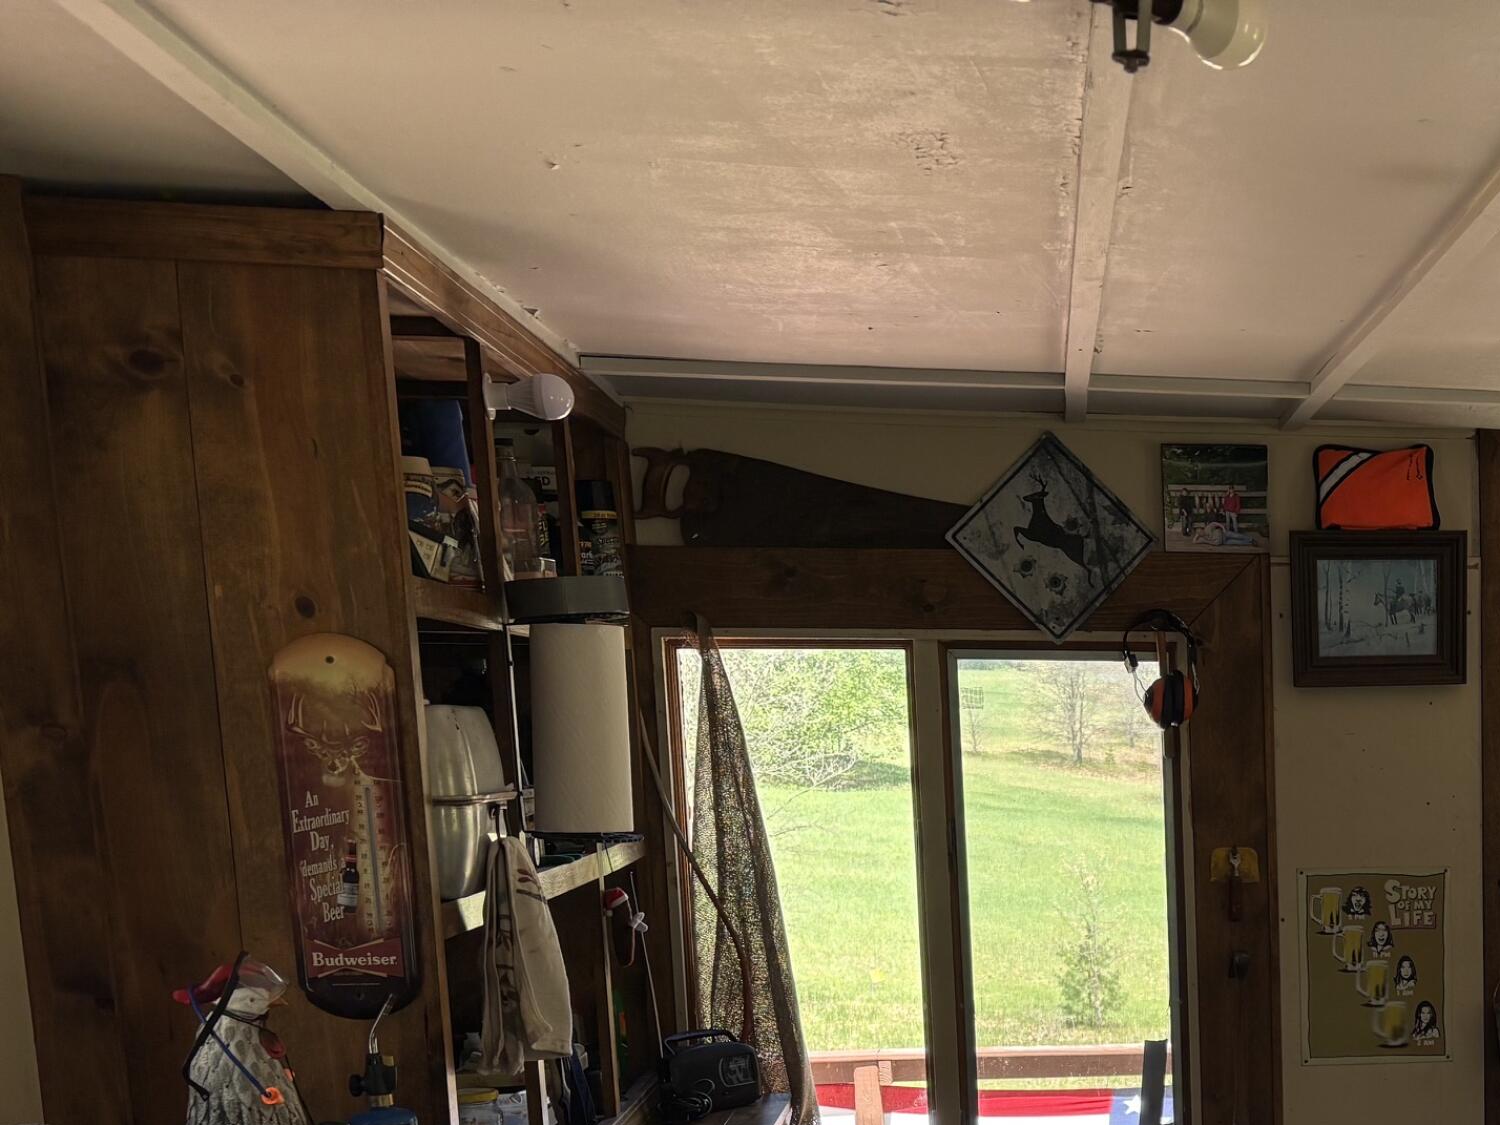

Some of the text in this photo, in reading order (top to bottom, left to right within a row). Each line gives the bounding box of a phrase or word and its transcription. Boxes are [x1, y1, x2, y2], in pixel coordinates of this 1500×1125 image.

[304, 790, 320, 809] An
[291, 807, 351, 834] Extraordinary
[301, 854, 338, 877] demands
[309, 872, 345, 903] Special
[1384, 879, 1438, 904] STORY
[322, 902, 345, 922] Beer
[1388, 904, 1435, 928] LIFE
[1397, 900, 1433, 911] OF MY
[312, 952, 397, 967] Budweiser
